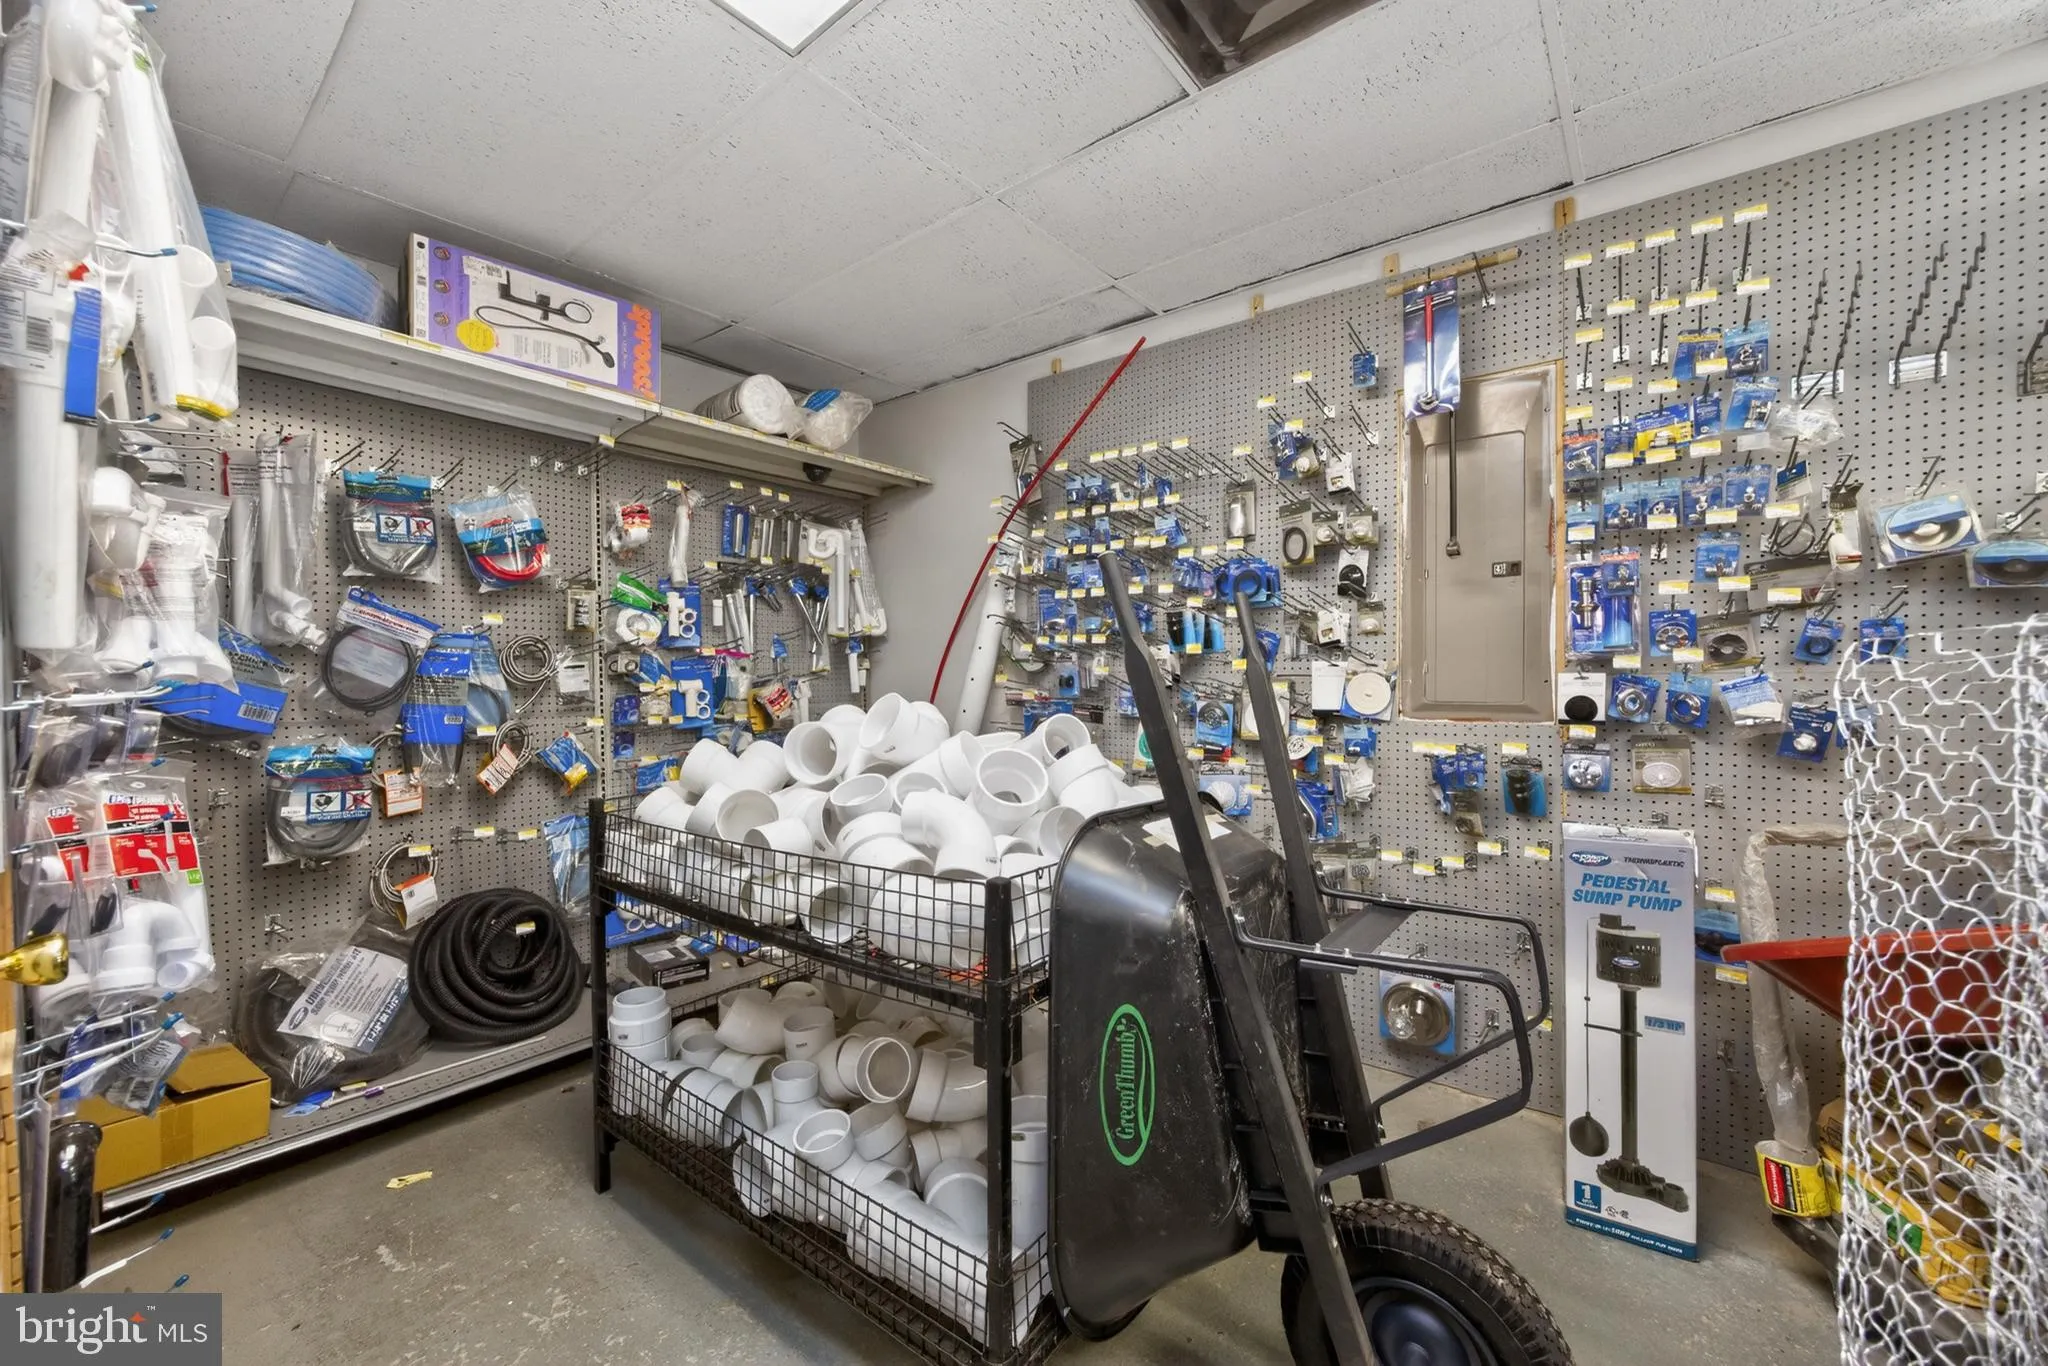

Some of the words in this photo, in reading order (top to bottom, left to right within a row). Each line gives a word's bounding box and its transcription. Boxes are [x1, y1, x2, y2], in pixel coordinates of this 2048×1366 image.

[1581, 873, 1671, 894] PEDESTAL
[1572, 889, 1624, 905] SUMP
[1628, 895, 1683, 912] PUMP
